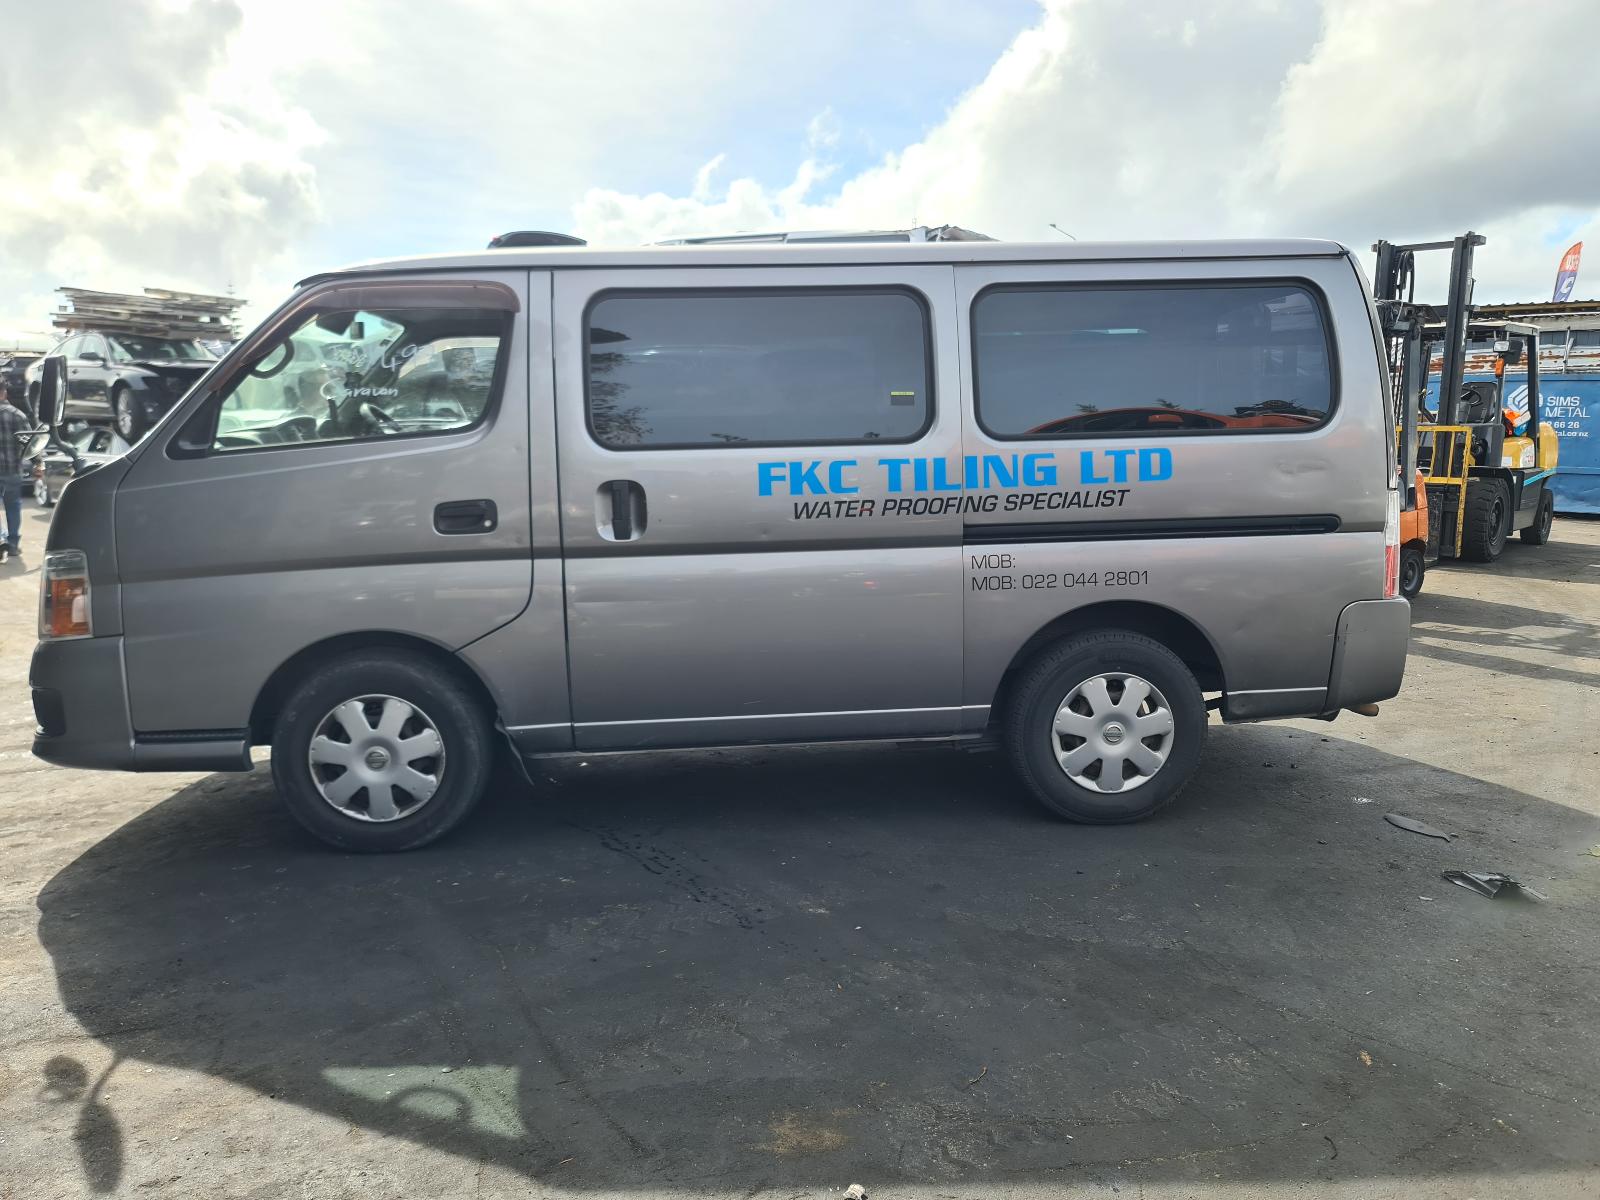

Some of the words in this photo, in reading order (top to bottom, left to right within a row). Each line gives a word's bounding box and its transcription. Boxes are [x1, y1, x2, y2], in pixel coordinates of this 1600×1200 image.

[319, 377, 399, 400] Caravan
[1546, 396, 1581, 407] SIMS
[1545, 407, 1591, 418] METAL
[757, 459, 860, 497] FKC
[877, 452, 1058, 492] TILING
[1079, 447, 1173, 485] LTD
[794, 499, 876, 520] WATER
[881, 494, 999, 517] PROOFING
[1003, 489, 1131, 512] SPECIALIST
[971, 554, 1016, 570] MOB:
[971, 575, 1017, 591] MOB:
[1021, 573, 1058, 589] 022
[1063, 572, 1099, 588] 044
[1104, 570, 1149, 587] 2801
